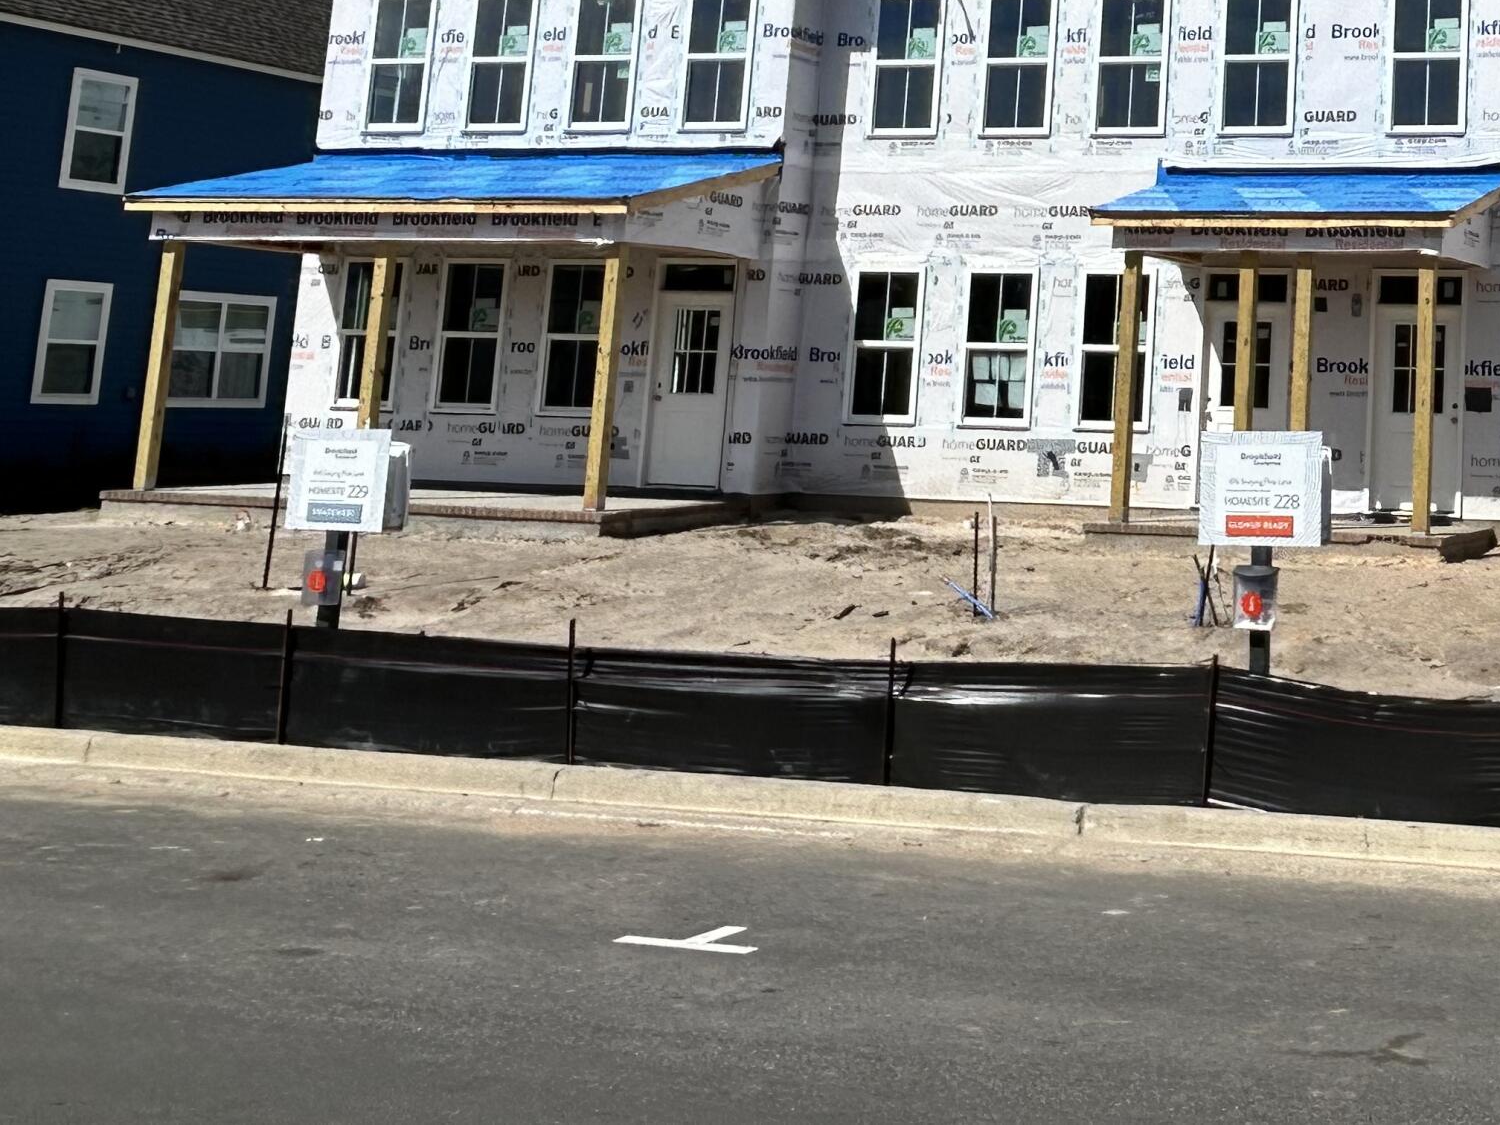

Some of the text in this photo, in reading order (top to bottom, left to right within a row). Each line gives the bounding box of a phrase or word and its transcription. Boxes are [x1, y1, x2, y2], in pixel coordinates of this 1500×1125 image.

[1304, 111, 1357, 123] GUARD
[916, 205, 998, 217] homeGUARD
[942, 438, 1026, 452] homeGUARD
[1224, 494, 1300, 509] HOMESITE 228
